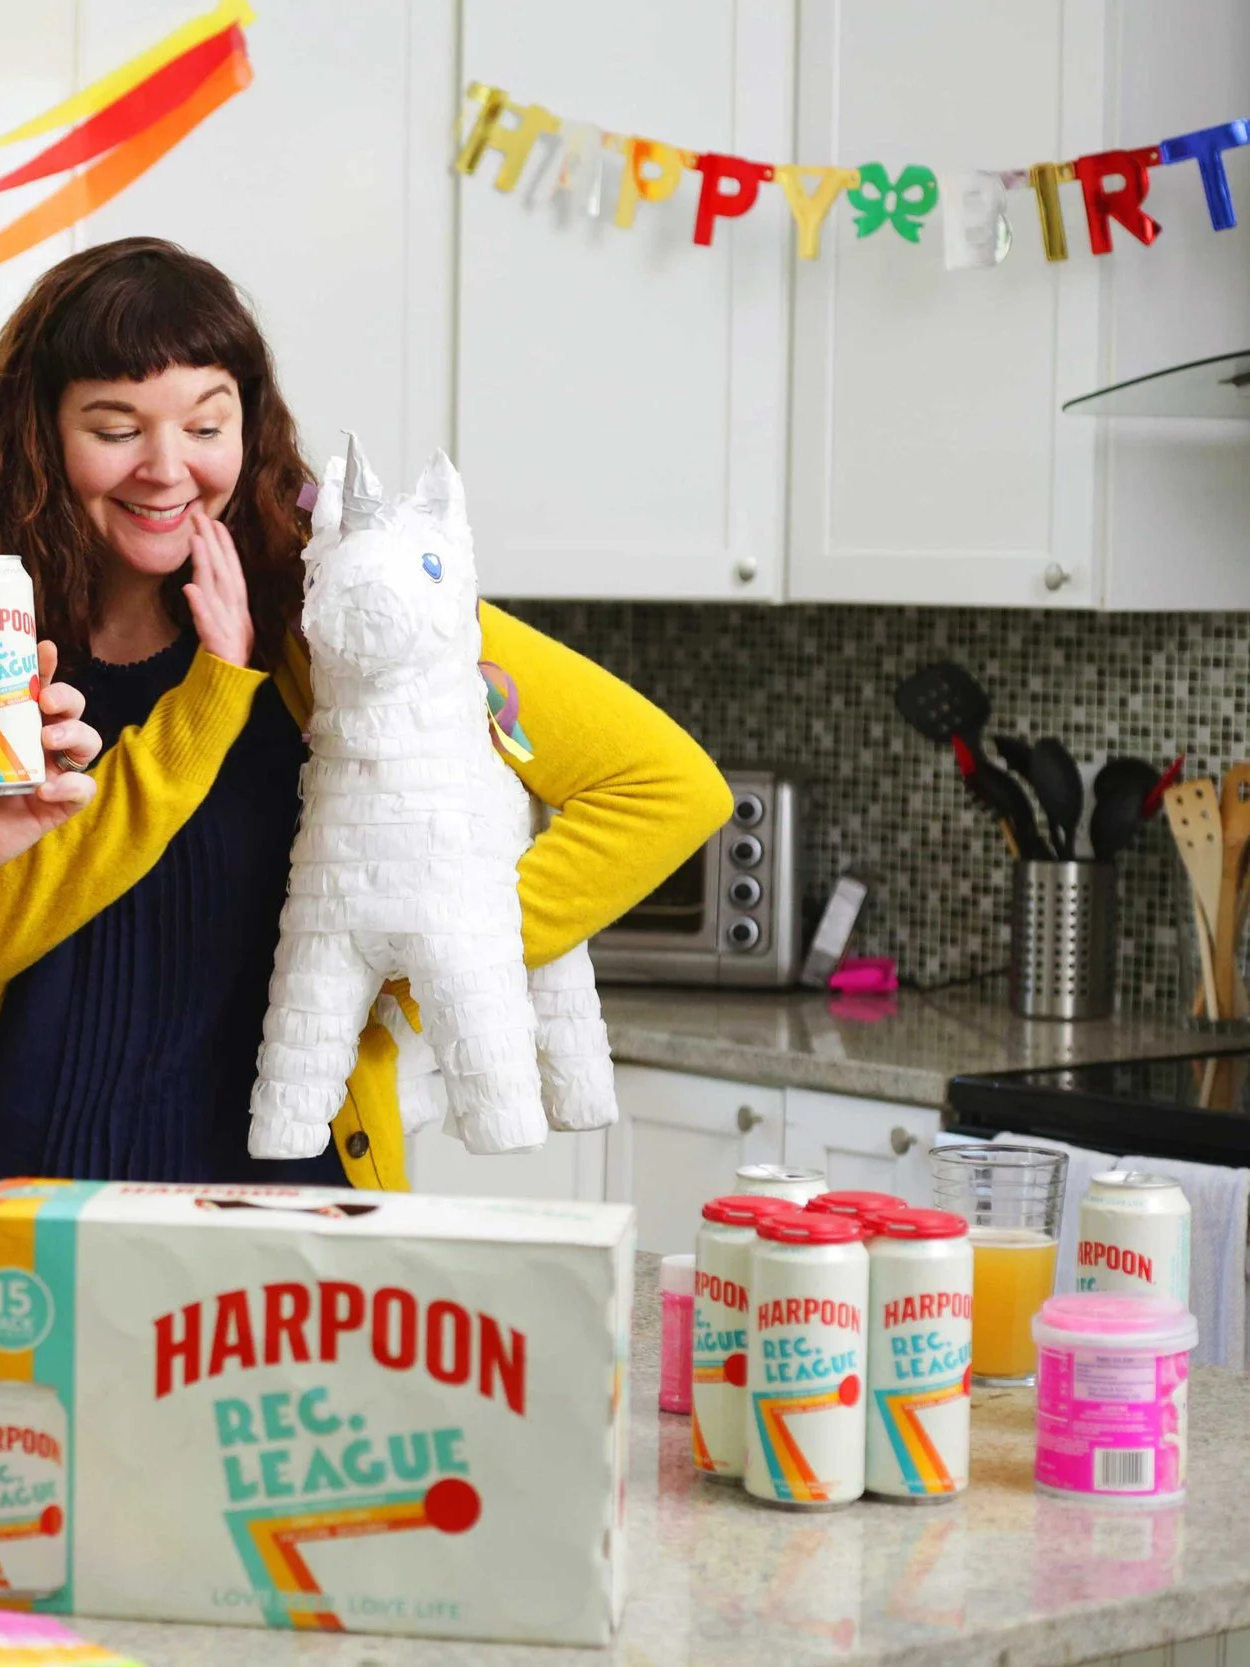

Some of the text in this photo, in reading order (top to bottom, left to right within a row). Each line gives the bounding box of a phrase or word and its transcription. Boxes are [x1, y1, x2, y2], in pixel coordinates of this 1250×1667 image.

[455, 82, 858, 260] HAPPY
[1078, 1240, 1153, 1284] ARPOON
[695, 1270, 749, 1313] RPOON
[884, 1292, 973, 1330] HARPOO
[758, 1298, 860, 1336] HARPOON
[152, 1279, 527, 1418] HARPOON
[763, 1336, 822, 1359] REC.
[892, 1331, 952, 1357] REC.
[894, 1342, 972, 1380] LEAGU
[765, 1349, 856, 1383] LEAGUE
[212, 1385, 367, 1448] REC.
[221, 1427, 470, 1502] LEAGUE
